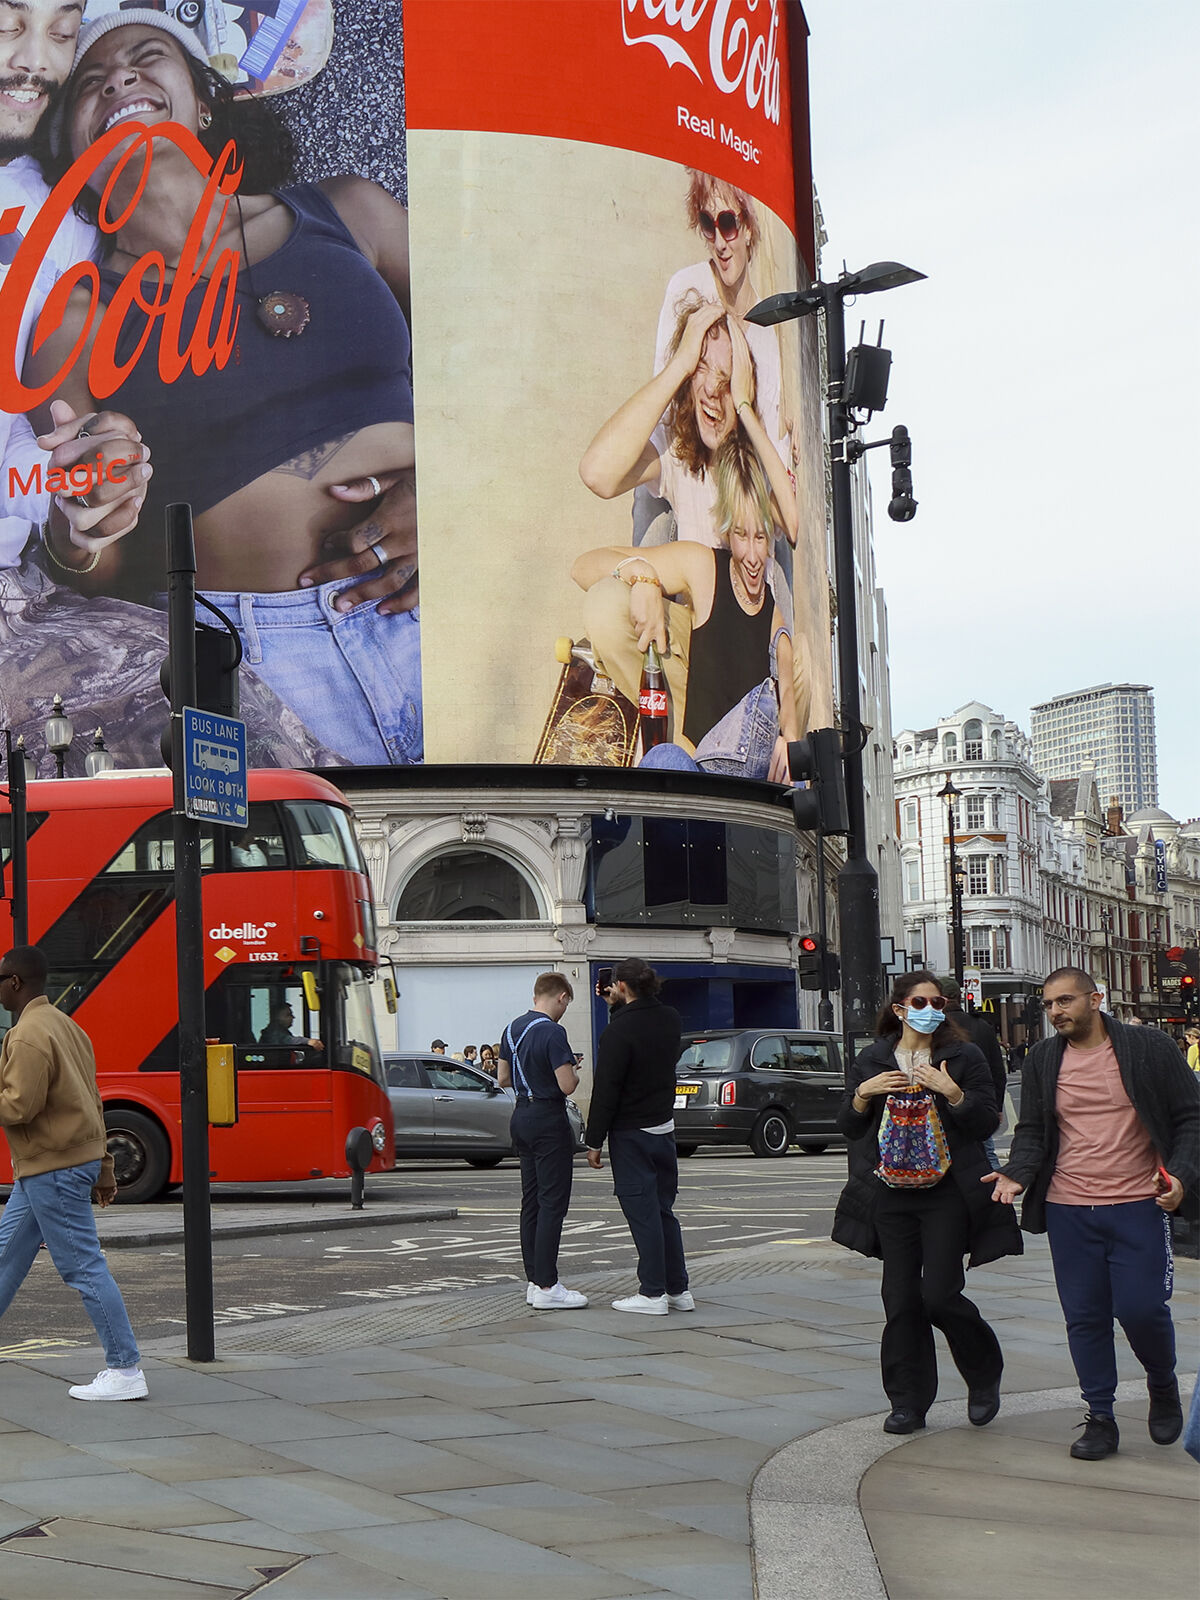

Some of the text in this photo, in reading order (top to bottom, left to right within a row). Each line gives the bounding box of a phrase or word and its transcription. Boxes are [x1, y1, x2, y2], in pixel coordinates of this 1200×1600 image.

[677, 105, 716, 139] Real
[191, 717, 239, 741] BUS LANE
[190, 775, 244, 798] LOOK BOTH
[1156, 848, 1166, 889] LYRIC
[209, 922, 268, 939] abellio
[249, 952, 279, 961] LT632
[338, 1277, 497, 1299] RIGHT
